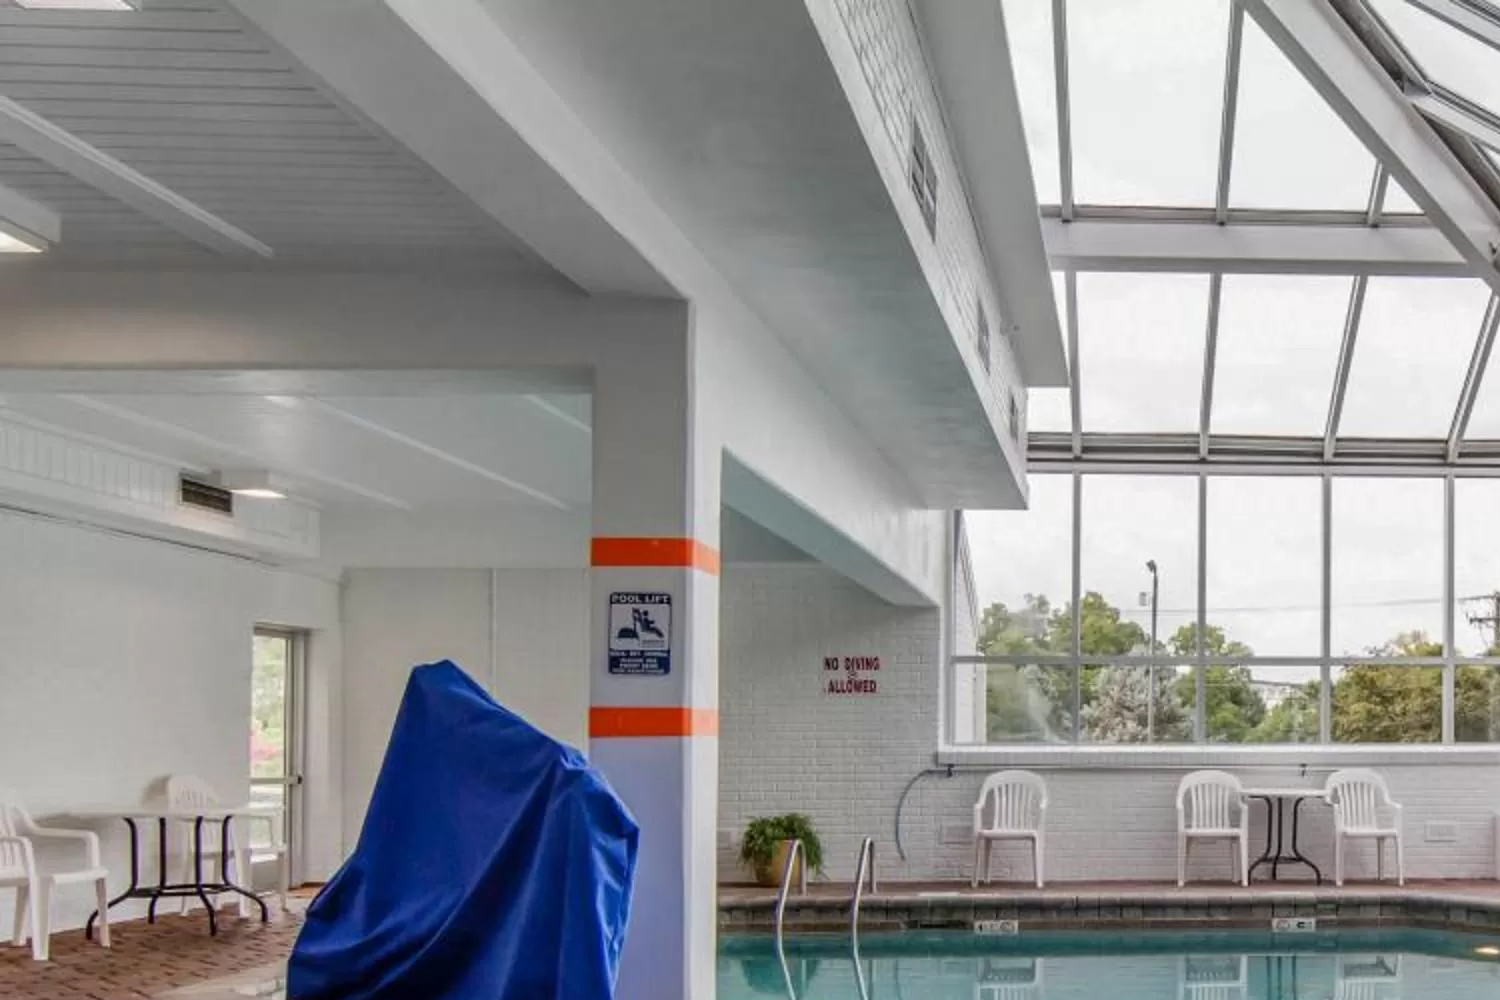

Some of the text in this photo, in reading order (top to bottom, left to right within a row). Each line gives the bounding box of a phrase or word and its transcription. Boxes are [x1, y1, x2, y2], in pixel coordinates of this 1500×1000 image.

[824, 655, 880, 671] NO DIVING
[828, 679, 877, 694] ALLOWED
